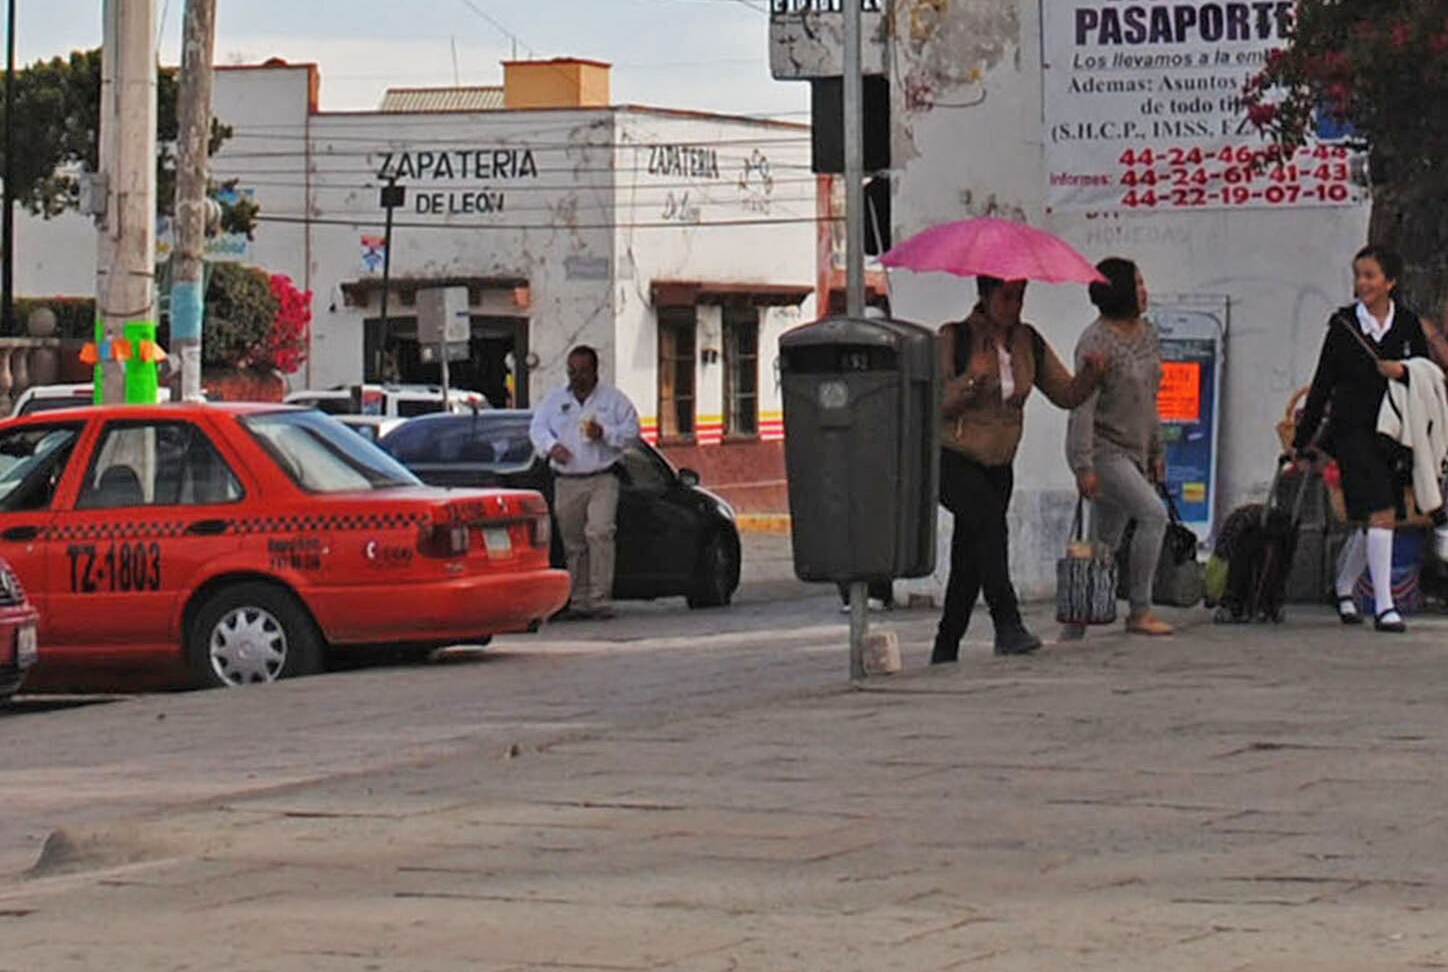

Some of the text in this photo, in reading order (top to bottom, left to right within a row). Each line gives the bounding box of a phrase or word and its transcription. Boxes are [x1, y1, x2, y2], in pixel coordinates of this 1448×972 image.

[1075, 1, 1293, 46] PASAPORTE
[1073, 52, 1106, 69] Los
[1112, 49, 1193, 68] llevamos
[1199, 53, 1209, 64] a
[1215, 48, 1230, 65] la
[1158, 75, 1237, 92] Asuntos
[1140, 97, 1164, 115] de
[1170, 95, 1213, 114] todo
[377, 149, 537, 179] ZAPATERIA
[648, 144, 720, 179] ZAPATERIA
[416, 193, 444, 214] DE
